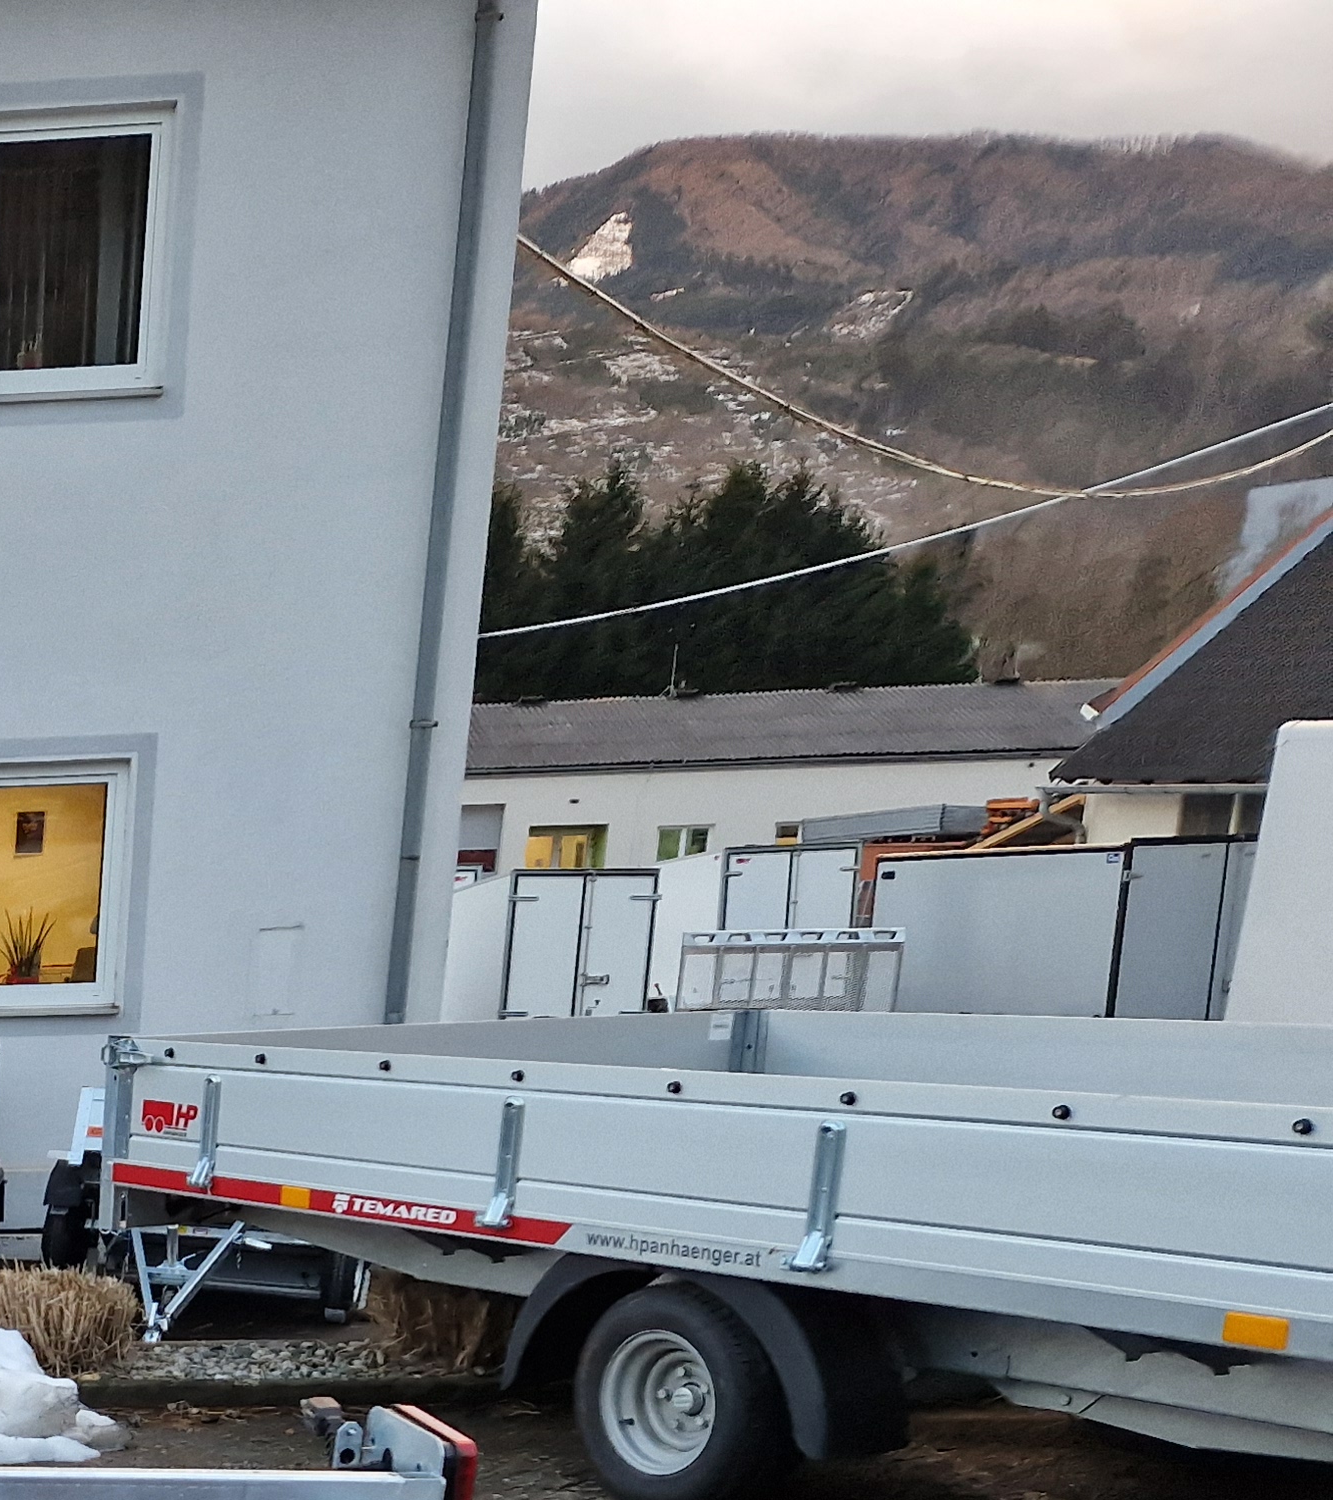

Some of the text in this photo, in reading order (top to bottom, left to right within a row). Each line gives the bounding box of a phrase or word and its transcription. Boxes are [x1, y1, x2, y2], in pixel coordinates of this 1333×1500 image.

[175, 1103, 198, 1128] HP
[351, 1197, 457, 1225] TEMARED
[586, 1231, 763, 1267] www.hpanhaenger.at
